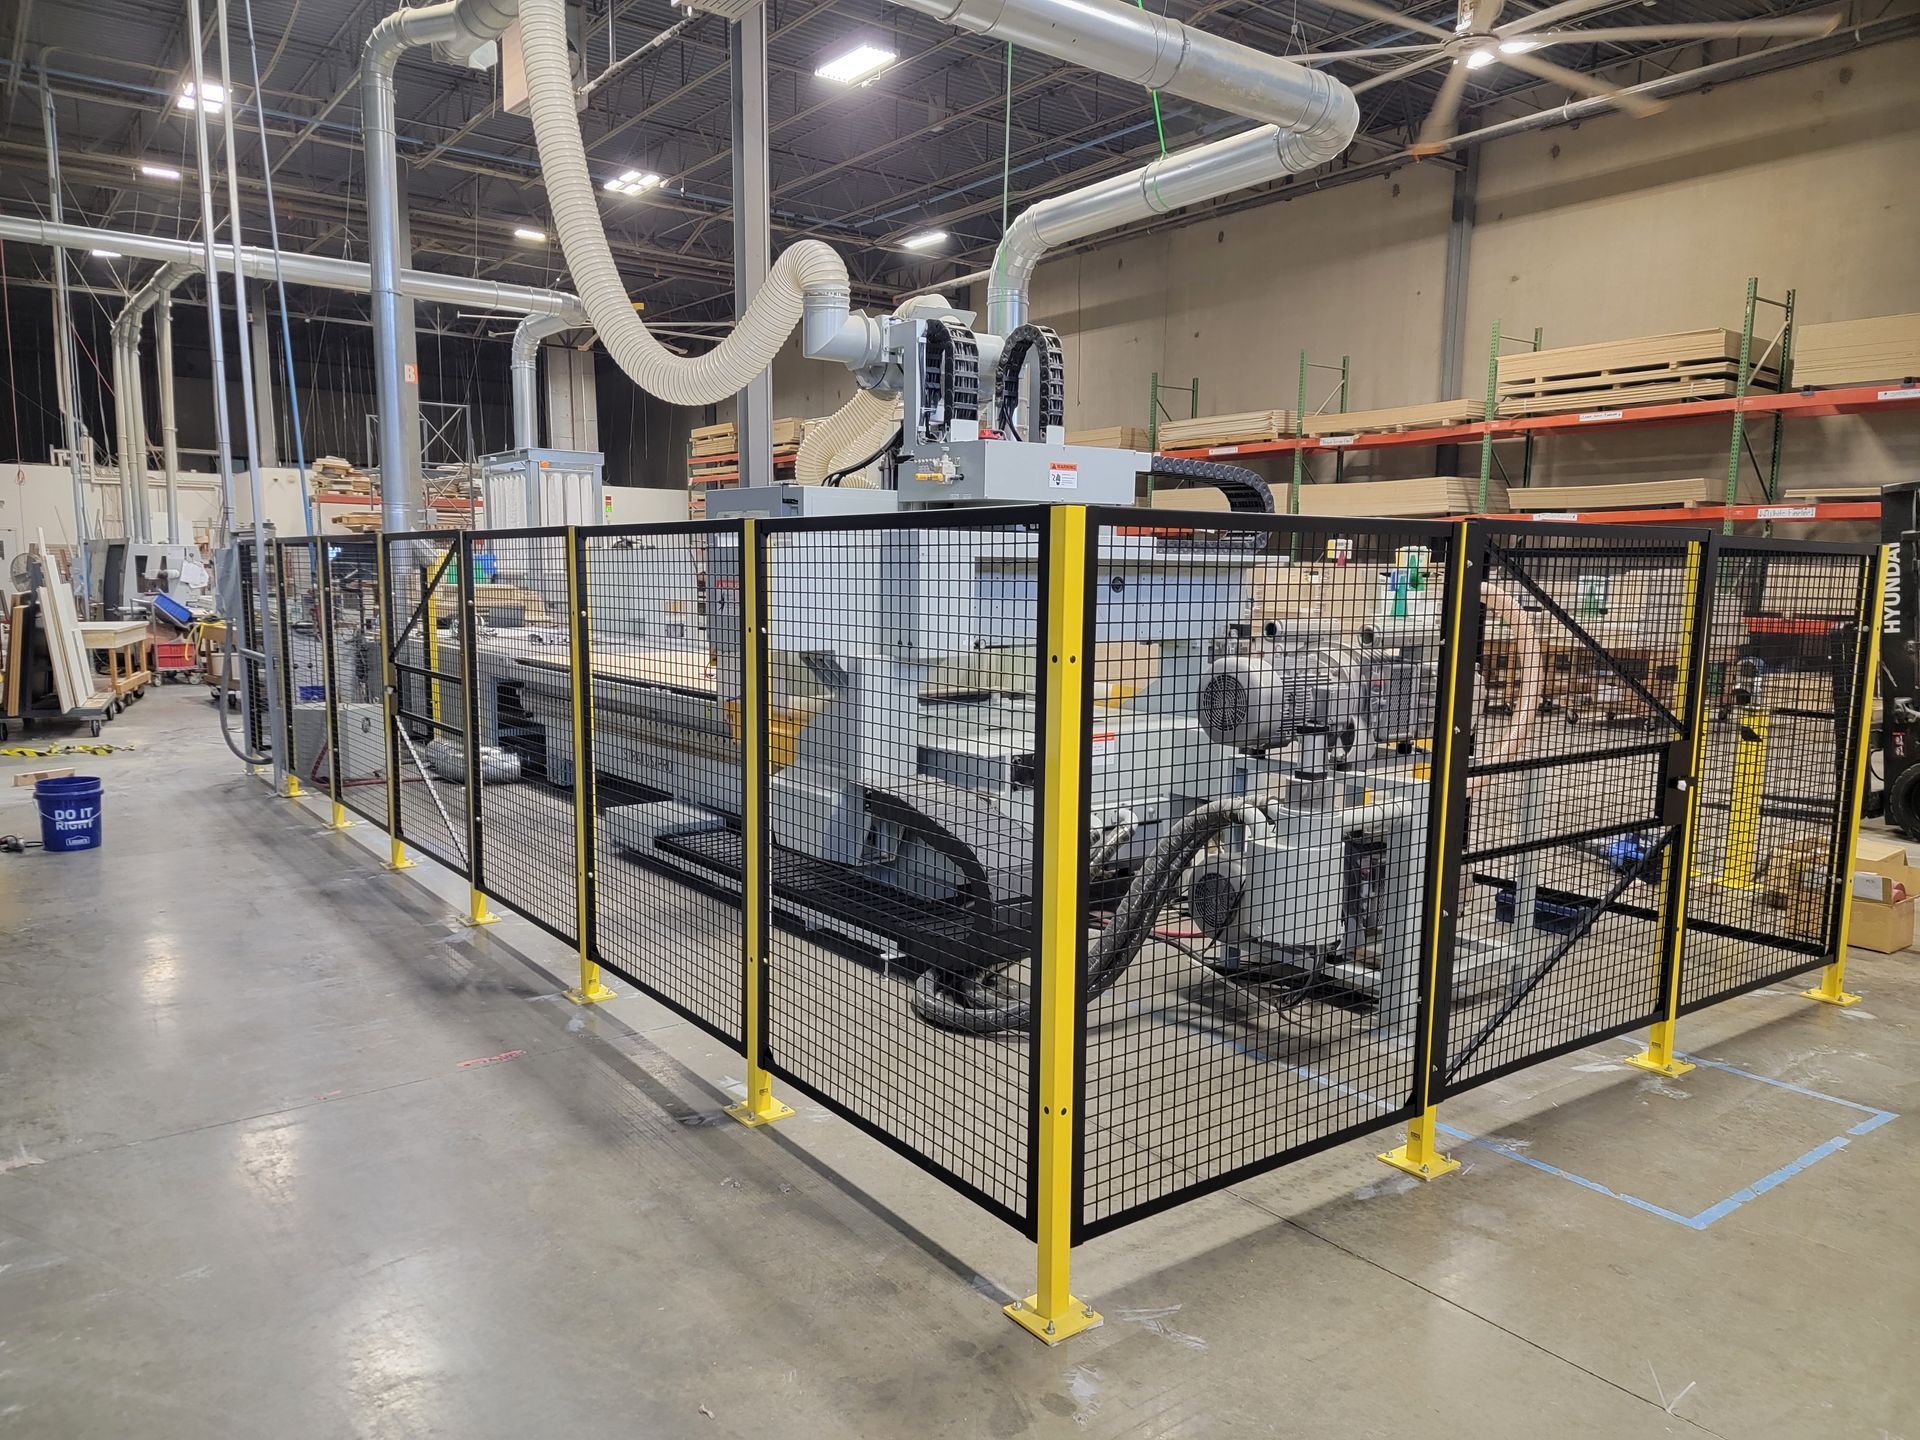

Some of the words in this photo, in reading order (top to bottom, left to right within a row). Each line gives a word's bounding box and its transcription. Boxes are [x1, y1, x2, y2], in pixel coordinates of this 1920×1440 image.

[405, 364, 415, 382] B
[1884, 542, 1901, 633] HYUNDAI
[54, 809, 76, 820] DO
[80, 807, 93, 819] IT
[55, 819, 94, 831] RIGHT
